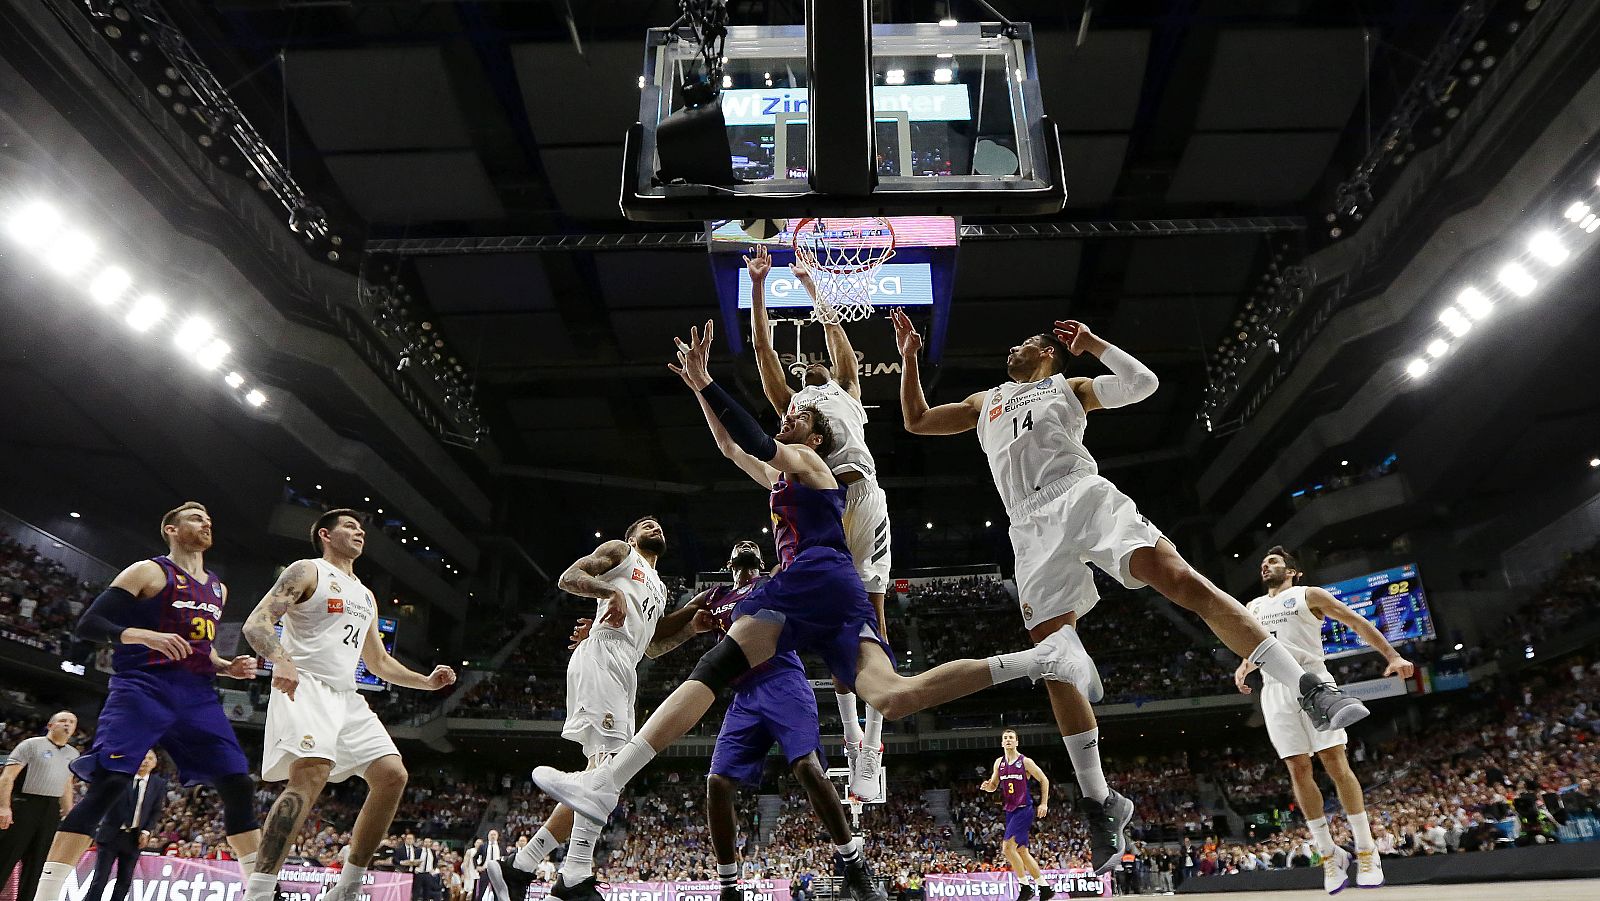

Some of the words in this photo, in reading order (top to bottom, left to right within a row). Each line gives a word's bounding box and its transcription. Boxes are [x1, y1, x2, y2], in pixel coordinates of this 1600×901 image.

[722, 93, 808, 118] wizin
[874, 93, 945, 114] nter
[1004, 387, 1057, 406] Universidad
[1004, 396, 1042, 413] Europea
[1012, 409, 1034, 440] 14
[1388, 580, 1410, 595] 92
[641, 596, 656, 622] 44
[710, 602, 737, 616] LASS
[190, 616, 216, 641] 30
[342, 624, 361, 649] 24
[1008, 782, 1015, 794] 3
[600, 886, 662, 901] vistar
[929, 880, 1007, 897] Movistar
[1077, 878, 1104, 895] Rey
